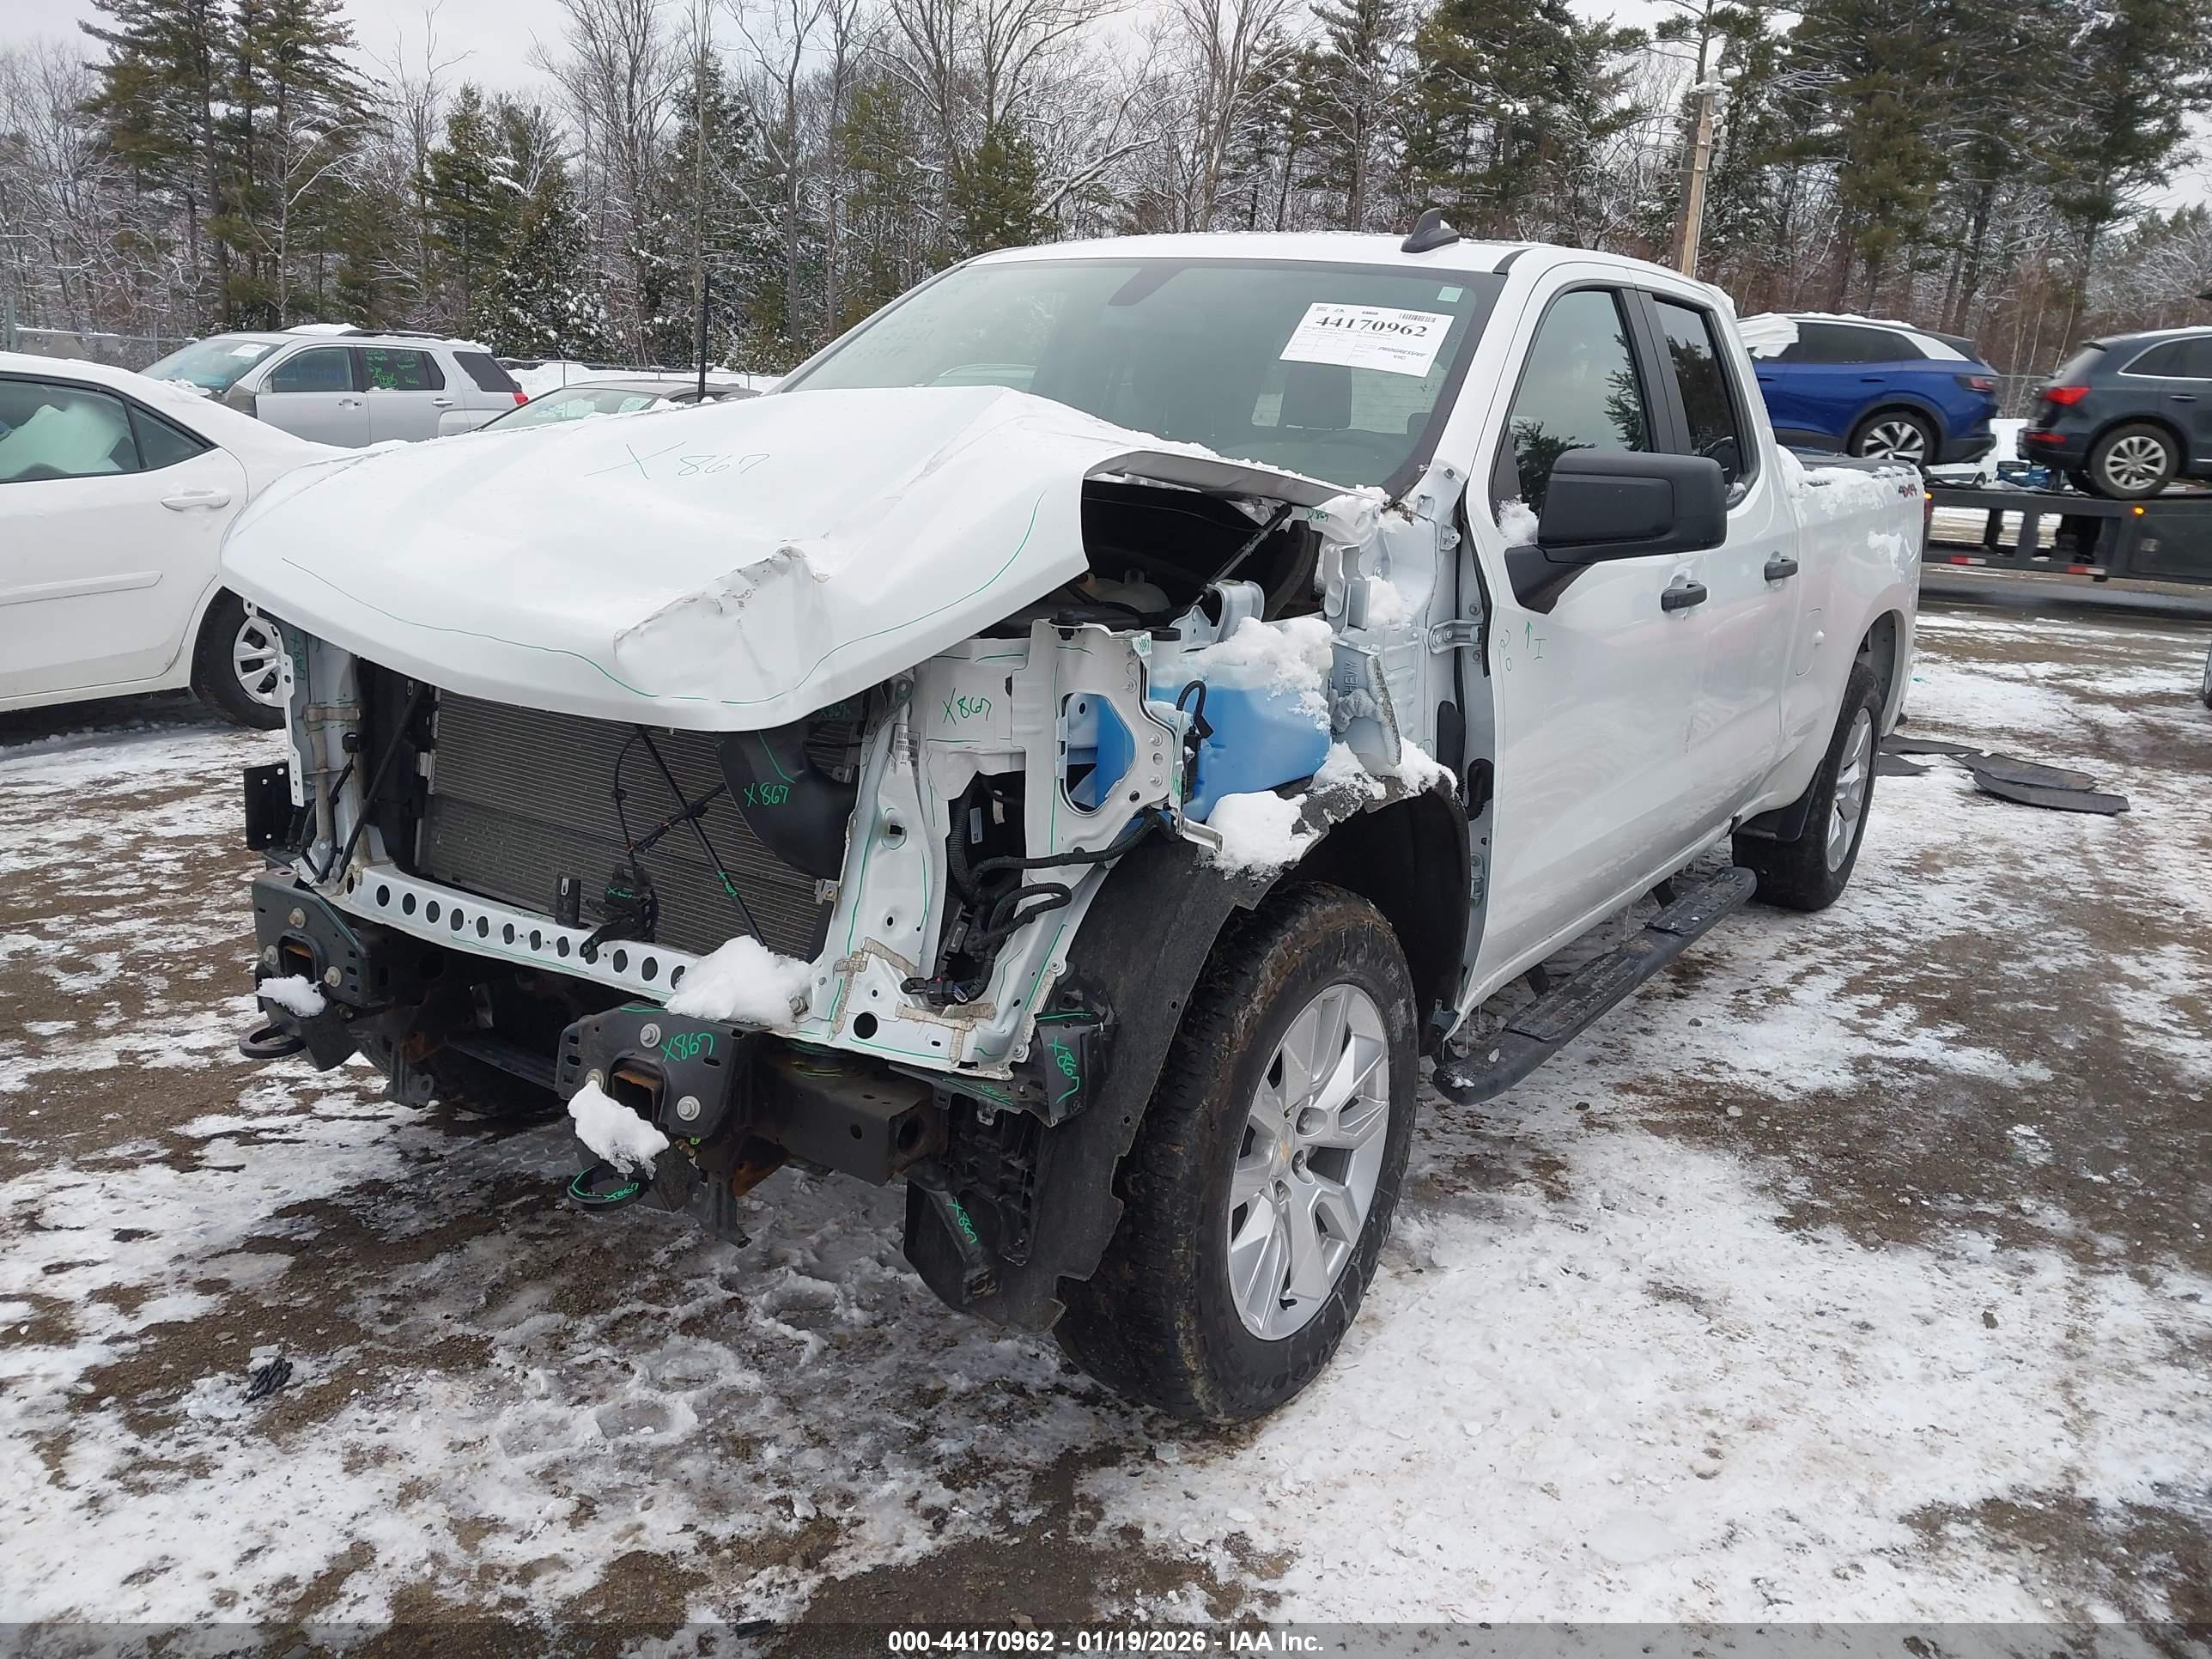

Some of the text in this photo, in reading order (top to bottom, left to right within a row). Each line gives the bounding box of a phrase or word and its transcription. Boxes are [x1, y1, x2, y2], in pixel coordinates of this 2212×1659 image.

[1316, 316, 1428, 337] 44170962
[942, 687, 992, 726] X867
[744, 781, 790, 808] X867
[660, 1033, 714, 1063] X867
[1047, 1036, 1080, 1104] X867
[604, 1182, 640, 1201] X867
[946, 1196, 978, 1244] X867
